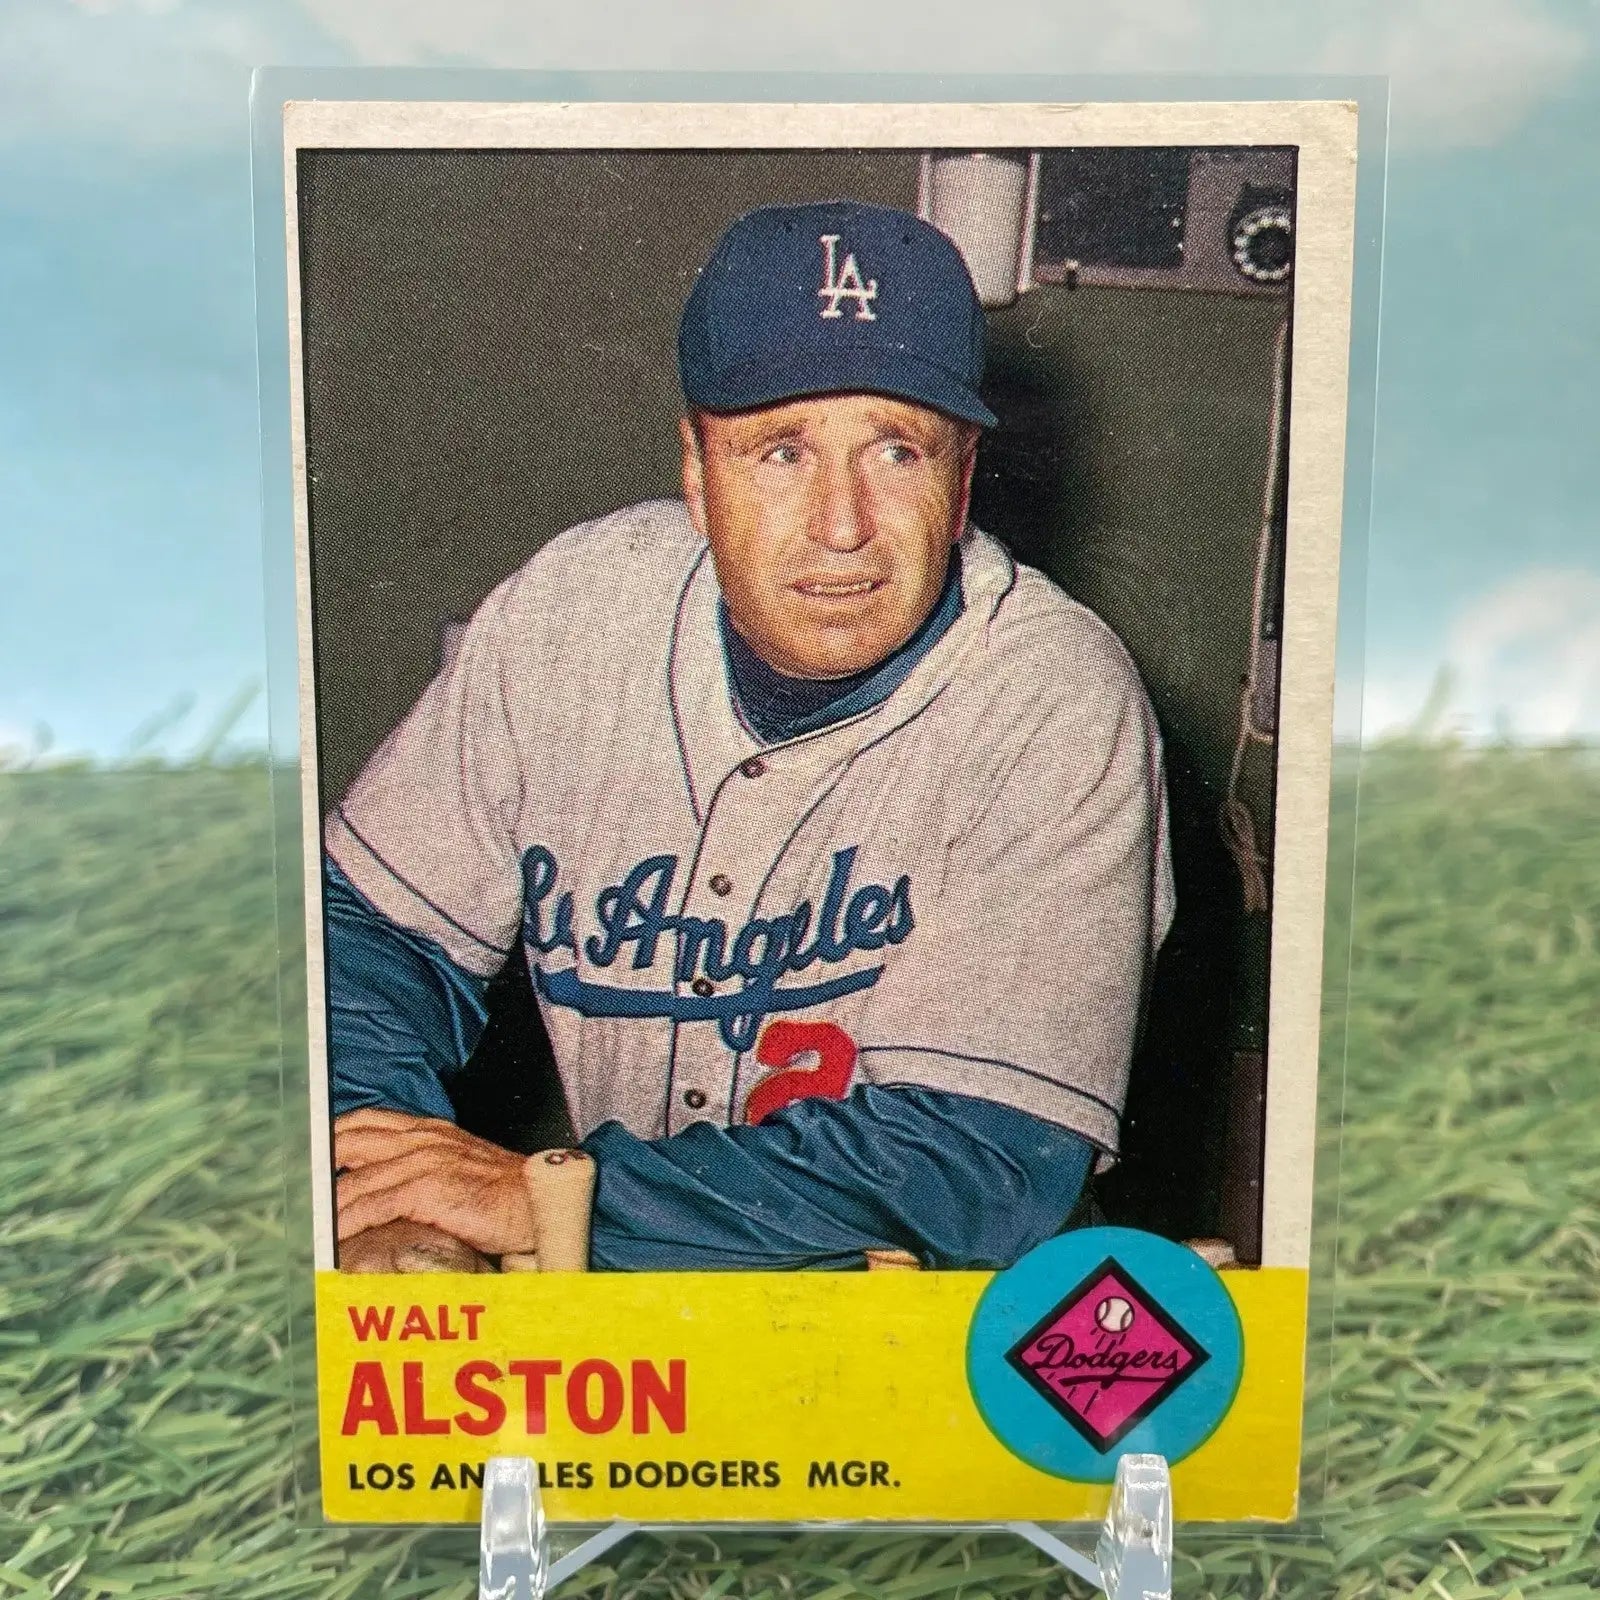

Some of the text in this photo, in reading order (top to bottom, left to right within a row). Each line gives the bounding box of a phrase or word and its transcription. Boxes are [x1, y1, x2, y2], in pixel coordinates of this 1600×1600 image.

[819, 234, 877, 320] LA
[746, 1020, 858, 1125] 2
[349, 1304, 485, 1341] WALT
[1030, 1333, 1180, 1389] Dodgers
[341, 1359, 687, 1437] ALSTON
[349, 1460, 902, 1491] LOS ANLES DODGERS MGR.
